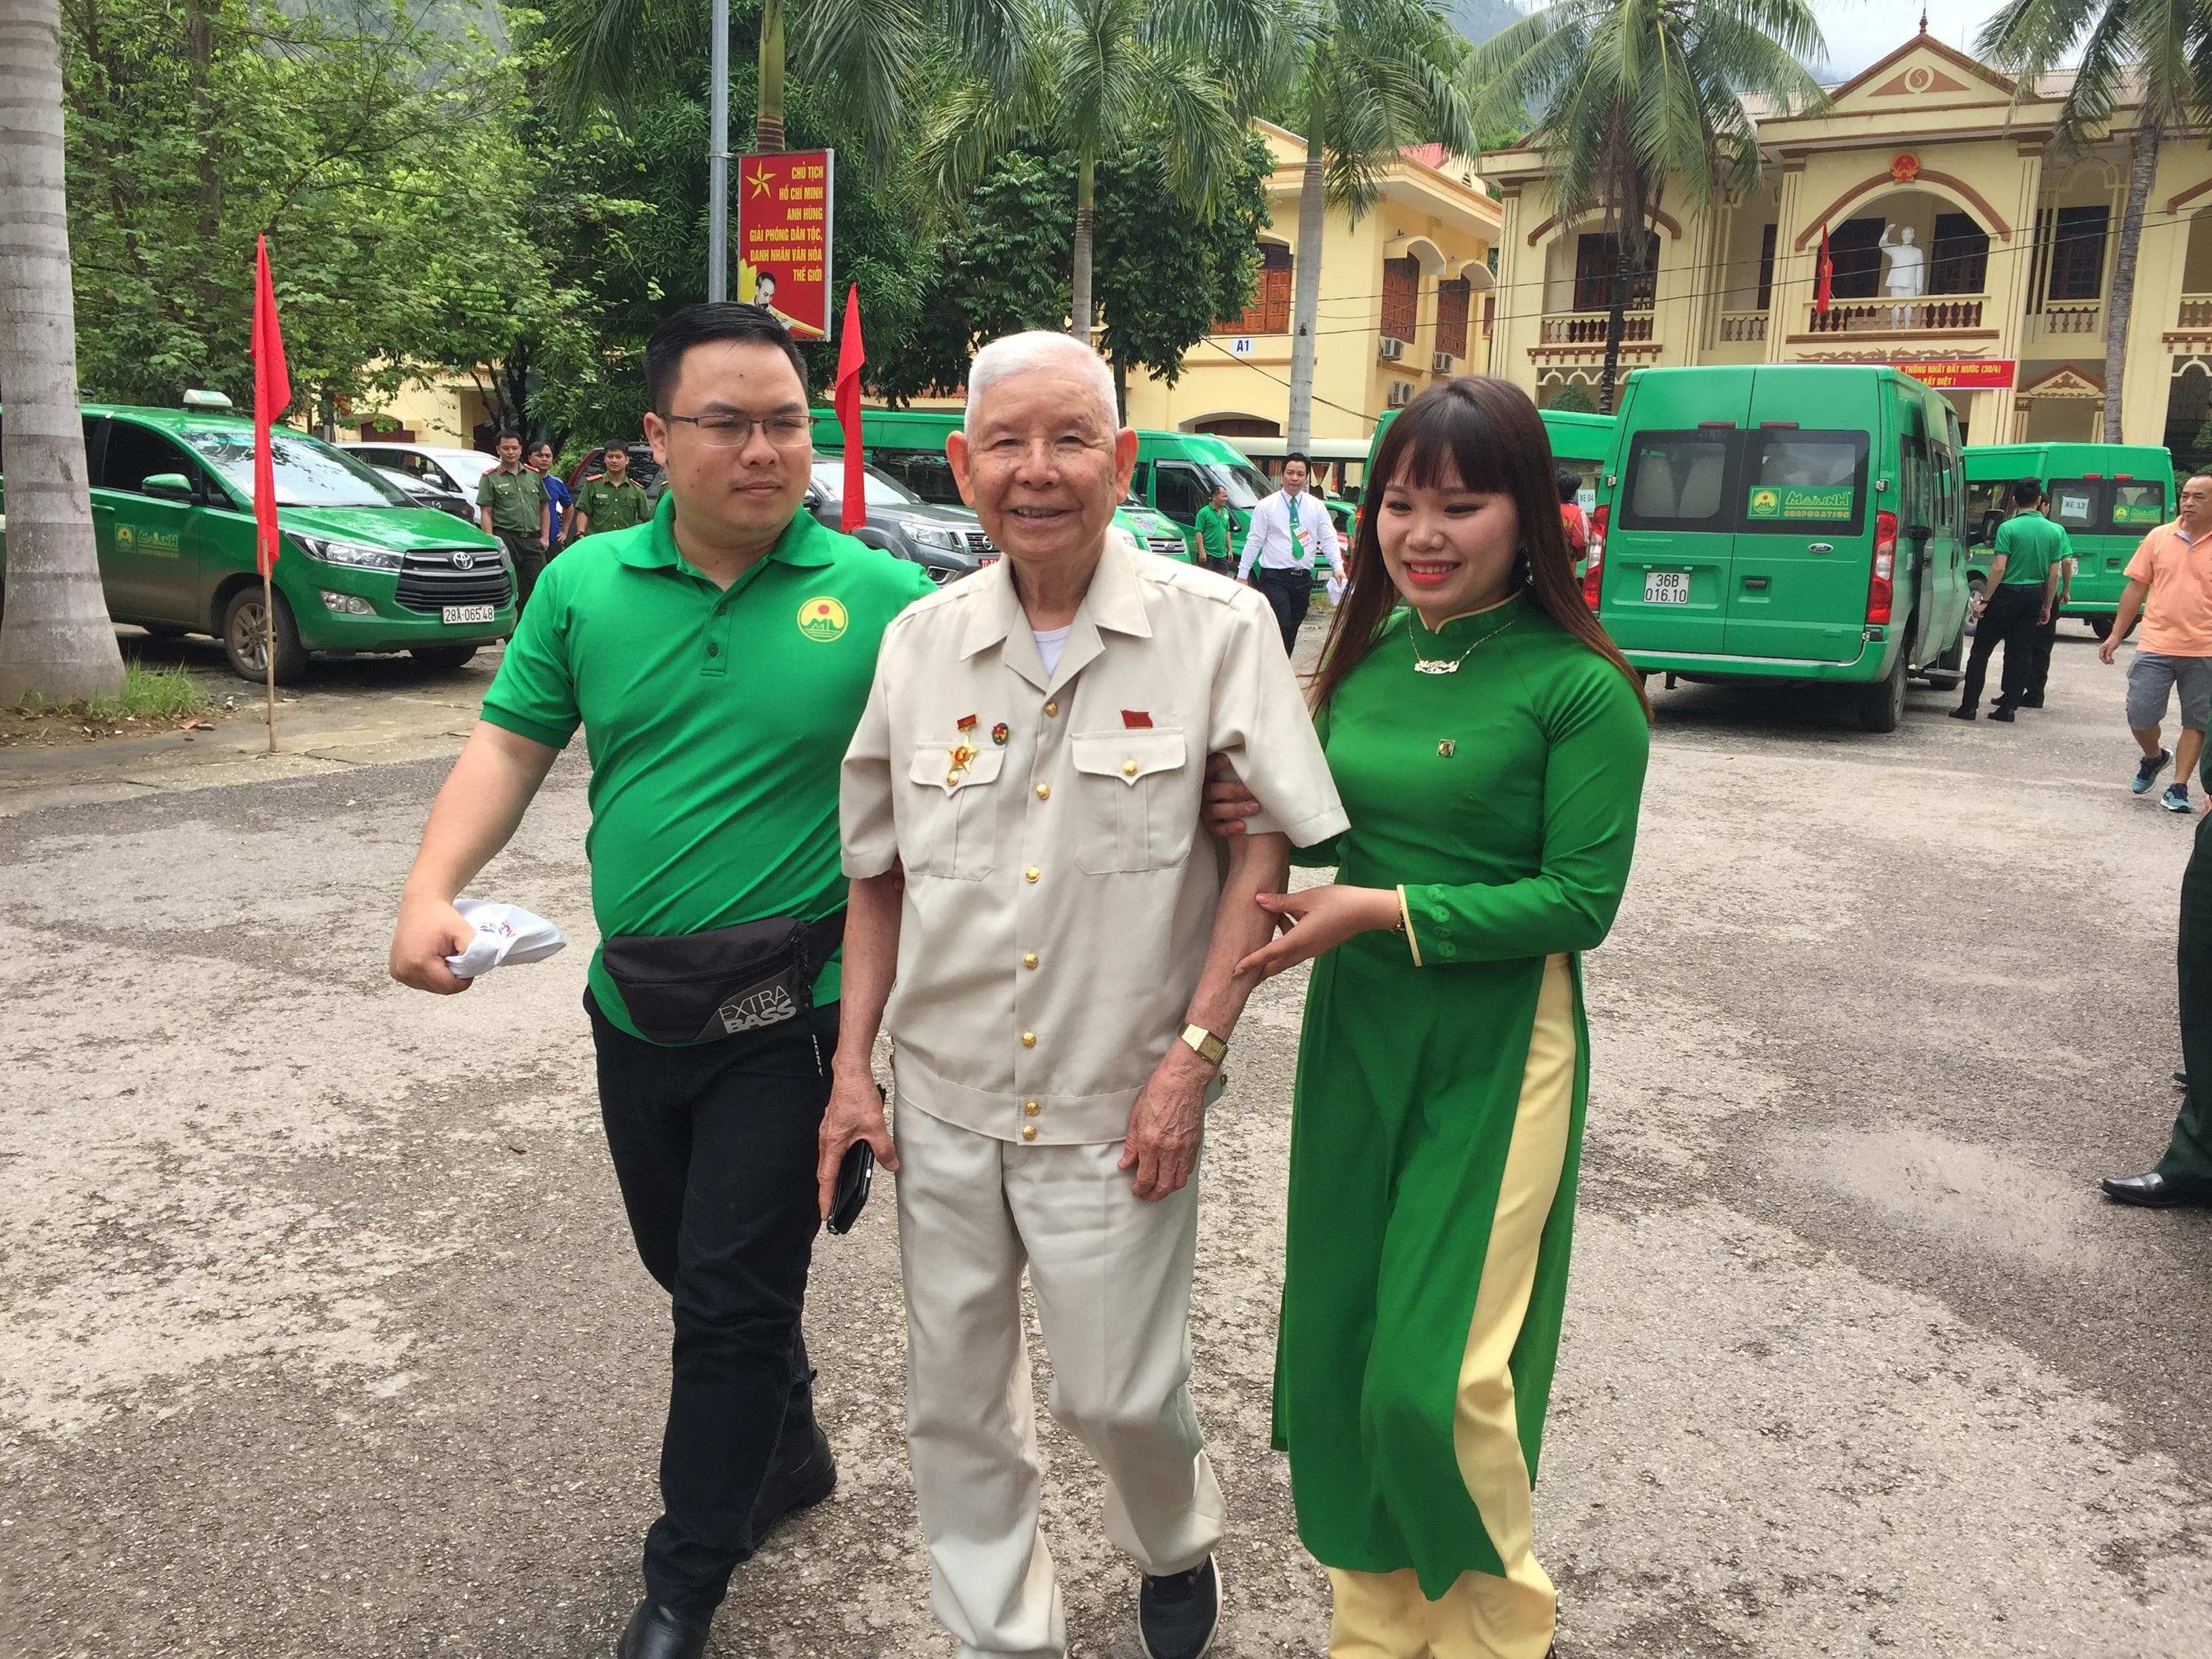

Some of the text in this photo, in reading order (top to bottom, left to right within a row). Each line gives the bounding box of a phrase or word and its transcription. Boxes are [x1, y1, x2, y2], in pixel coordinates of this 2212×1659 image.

[804, 186, 823, 200] MINH
[787, 207, 802, 221] ANH
[750, 249, 769, 262] DANH
[1236, 340, 1249, 352] A1
[1784, 510, 1849, 518] CORPORATION
[1656, 574, 1679, 588] 36B
[1645, 588, 1687, 602] 016.10
[718, 985, 790, 1021] EXTRA
[723, 998, 796, 1033] BASS
